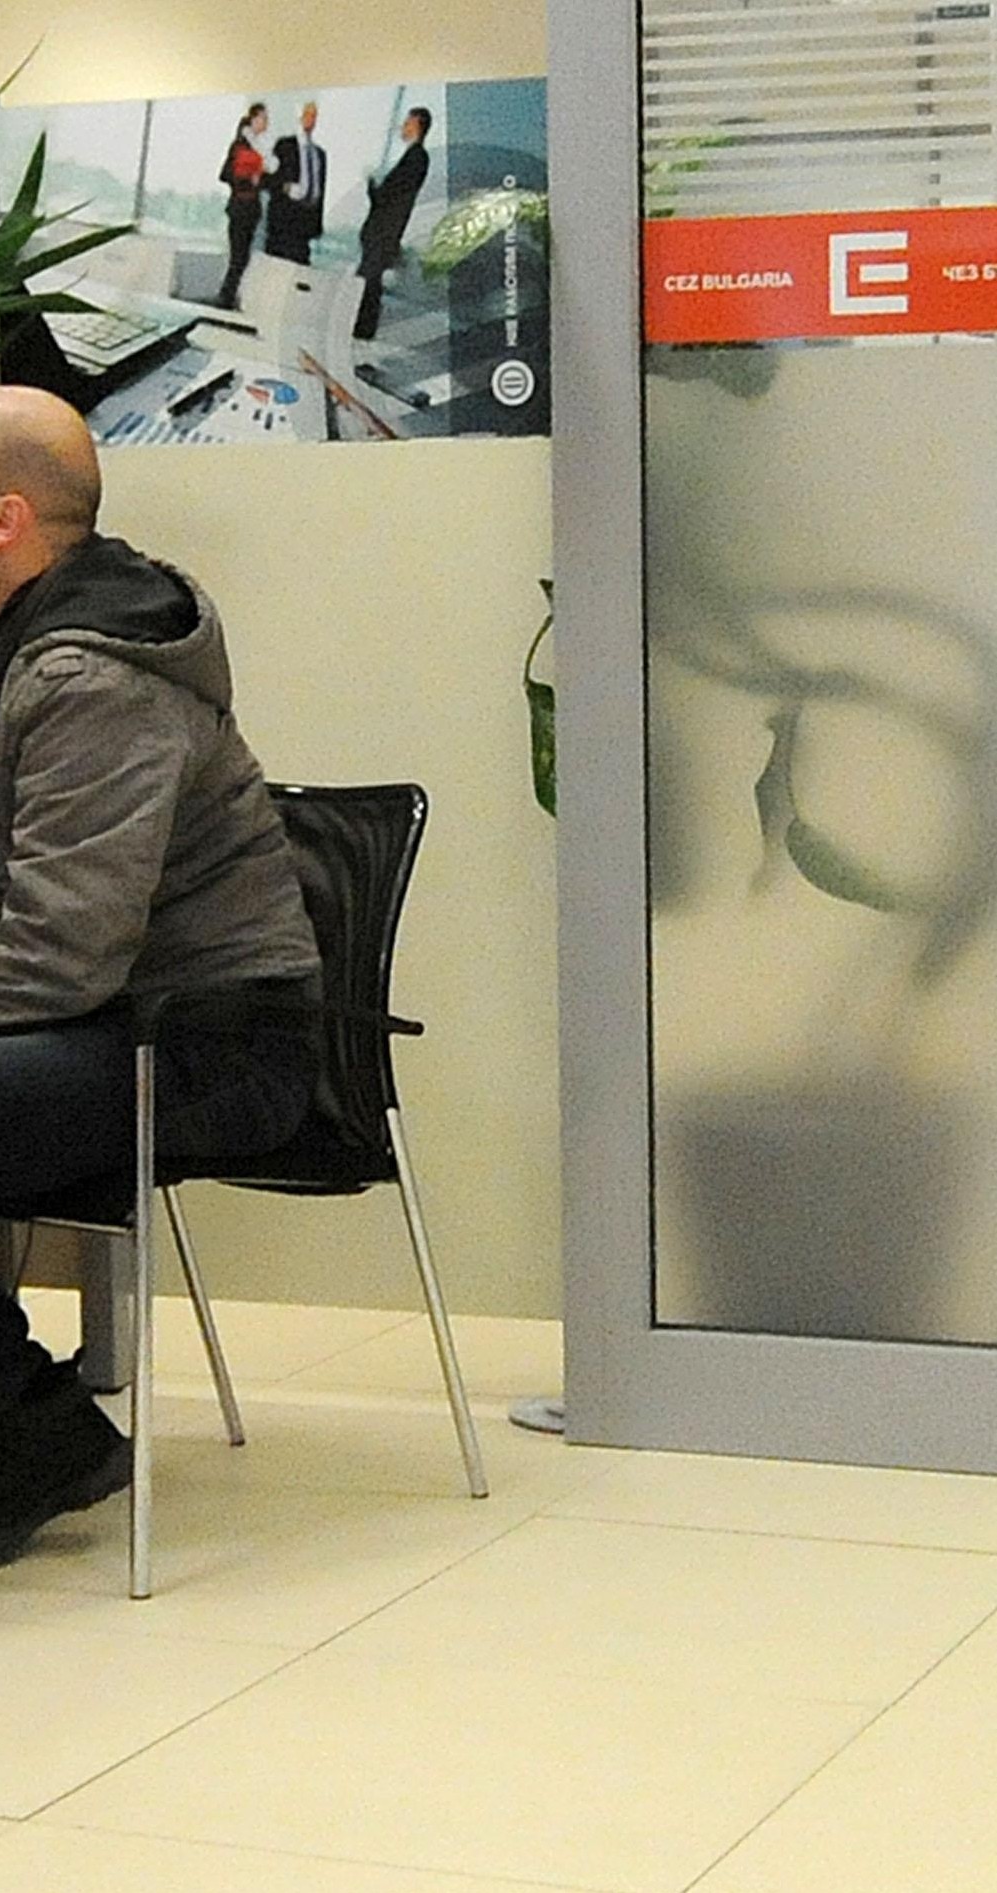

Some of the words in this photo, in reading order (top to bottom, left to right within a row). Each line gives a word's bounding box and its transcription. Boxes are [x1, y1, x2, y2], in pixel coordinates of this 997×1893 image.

[664, 274, 700, 293] CEZ
[702, 271, 794, 292] BULGARIA
[942, 263, 979, 282] ЧЕЗ
